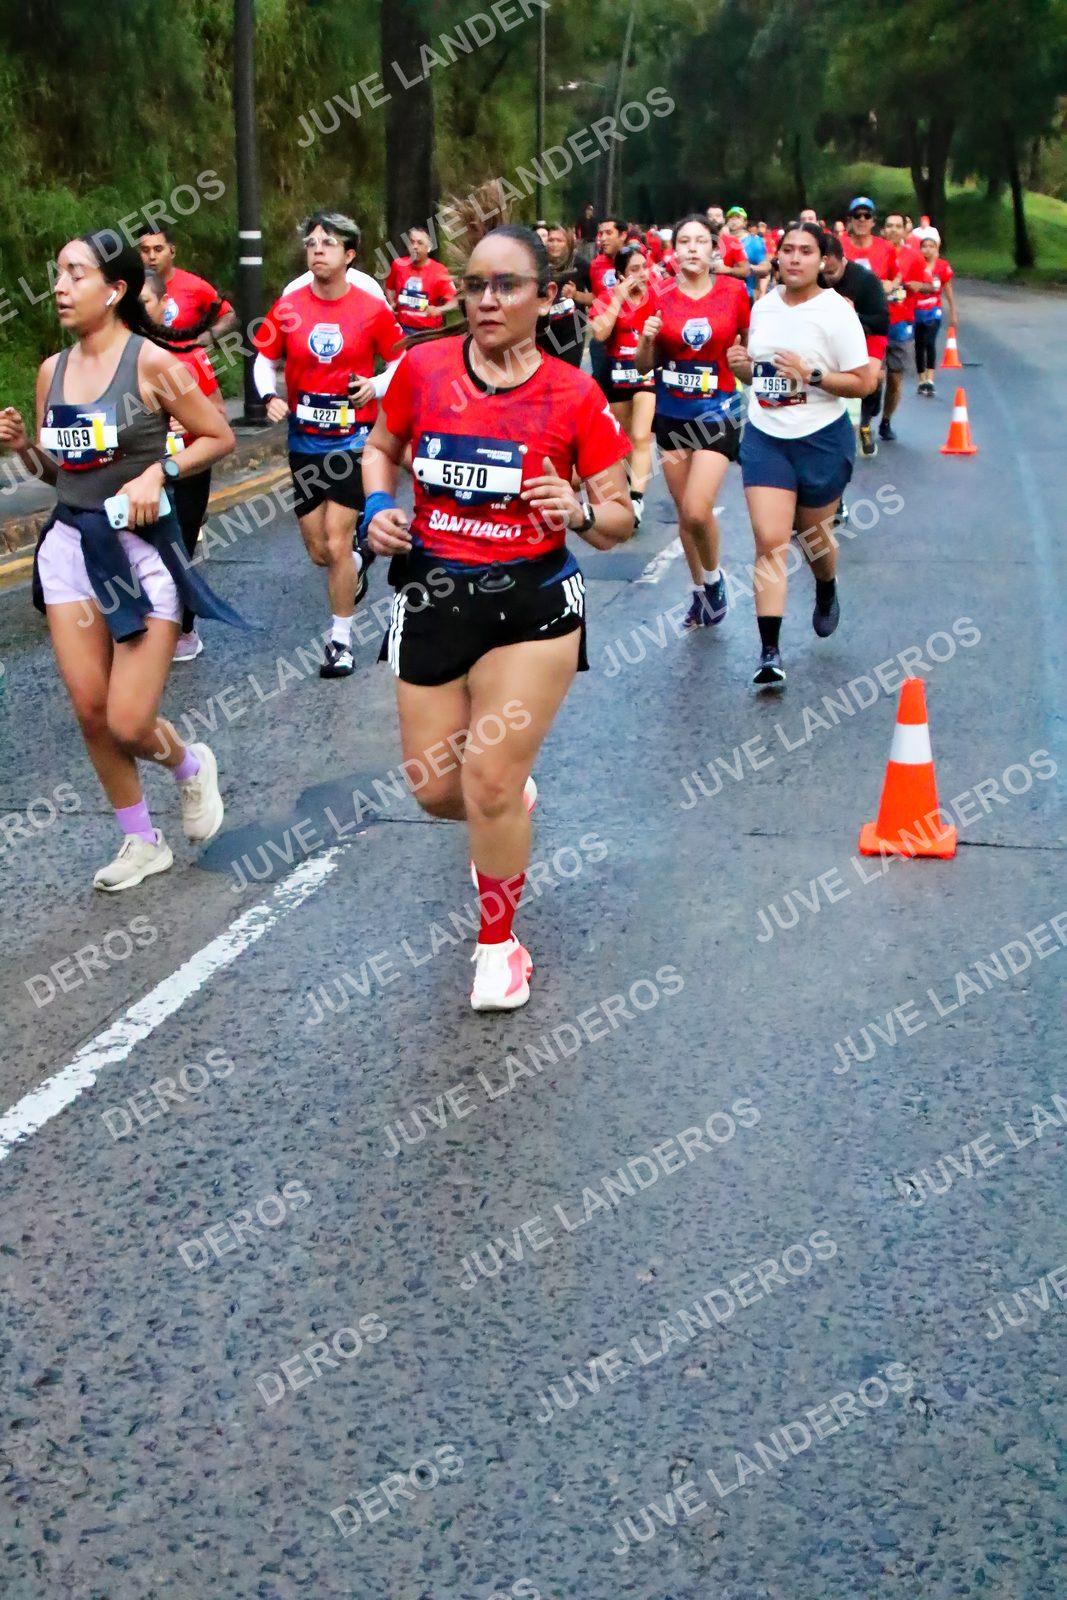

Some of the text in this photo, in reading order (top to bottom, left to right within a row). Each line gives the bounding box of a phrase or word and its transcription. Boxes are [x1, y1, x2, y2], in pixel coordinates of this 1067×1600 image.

[678, 374, 701, 386] 5372
[763, 378, 788, 391] 4965
[313, 409, 337, 421] 4227
[57, 429, 91, 447] 4069
[442, 463, 488, 488] 5570
[429, 509, 522, 540] SANTIAGO
